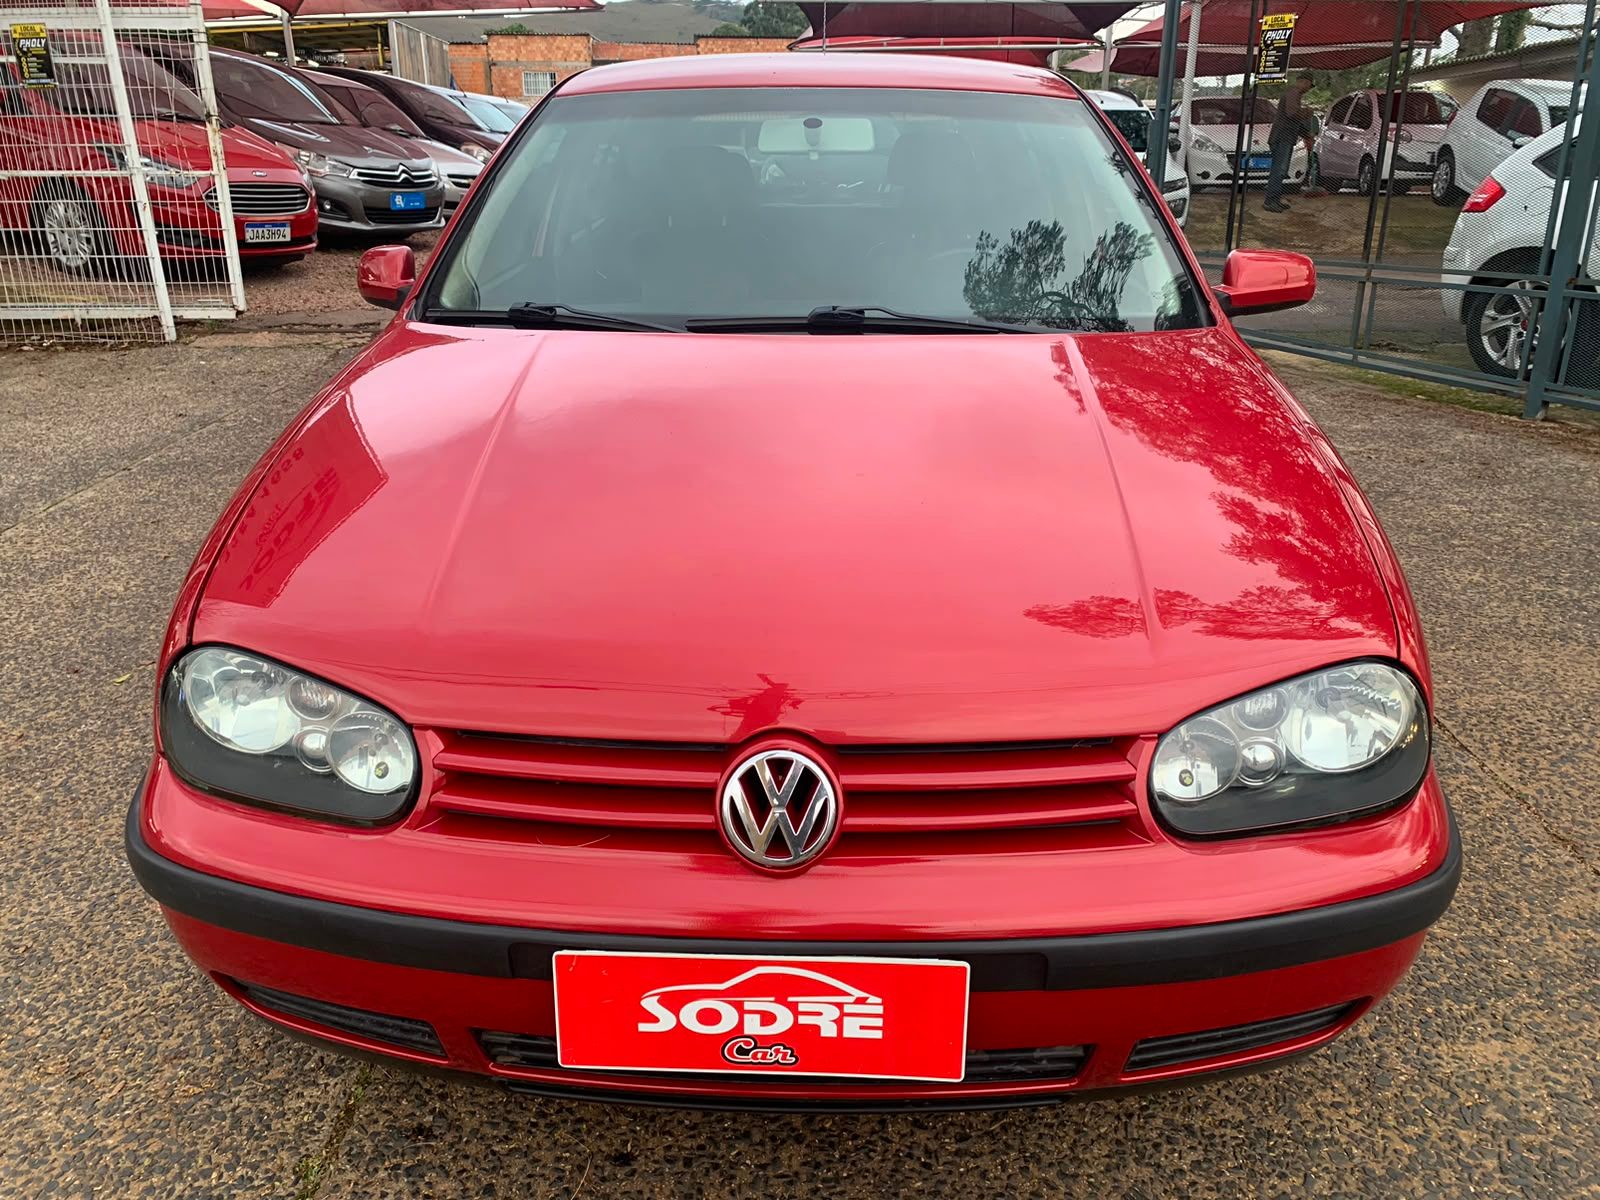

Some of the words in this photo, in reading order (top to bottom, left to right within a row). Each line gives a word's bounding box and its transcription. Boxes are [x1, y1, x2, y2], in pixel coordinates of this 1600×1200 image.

[1265, 29, 1292, 40] PHOLY
[20, 38, 46, 48] PHOLY
[249, 229, 286, 240] JAA3H94
[638, 995, 883, 1039] SODRÉ
[722, 1036, 798, 1065] Car
